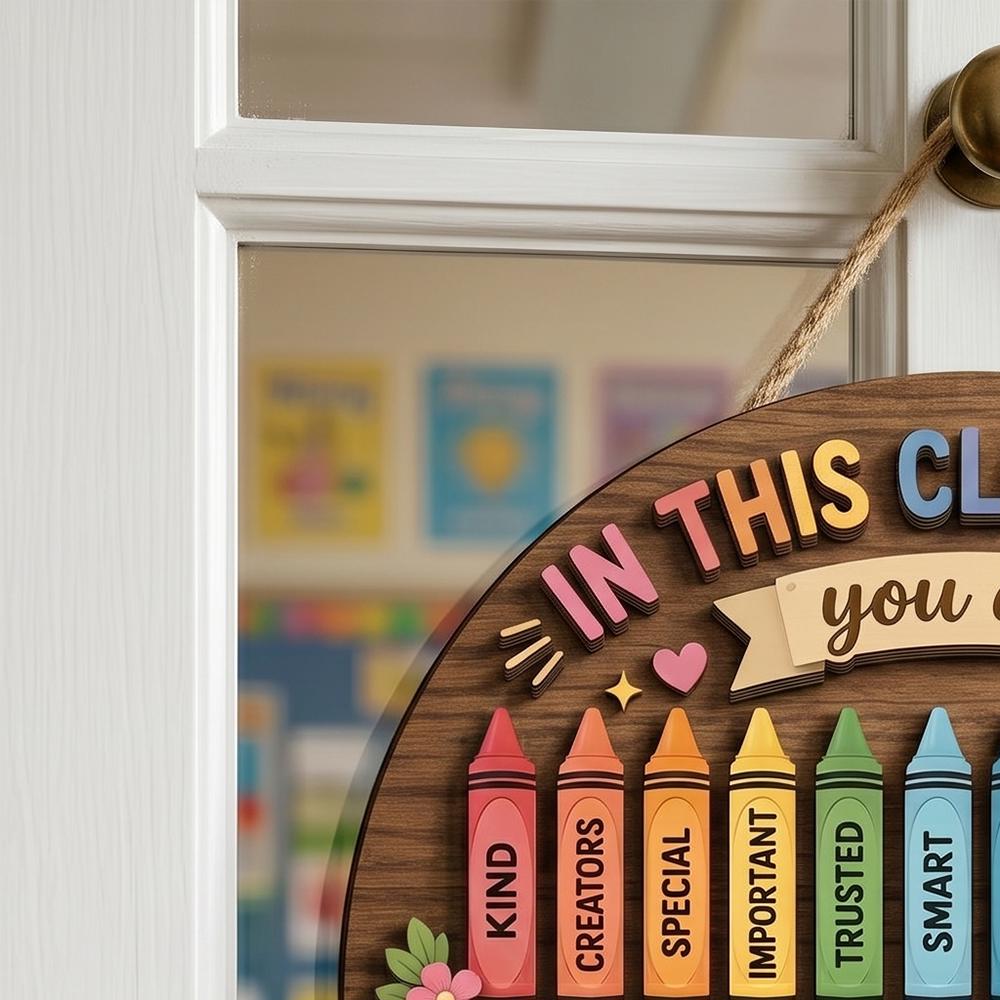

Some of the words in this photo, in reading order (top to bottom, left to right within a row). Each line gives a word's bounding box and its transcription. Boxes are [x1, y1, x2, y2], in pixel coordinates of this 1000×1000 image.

[541, 523, 659, 650] IN
[653, 439, 870, 579] THIS
[822, 582, 971, 657] you
[485, 841, 518, 939] KIND
[575, 817, 605, 972] CREATORS
[661, 827, 691, 958] SPECIAL
[748, 807, 777, 979] IMPORTANT
[835, 820, 865, 968] TRUSTED
[922, 830, 953, 953] SMART
